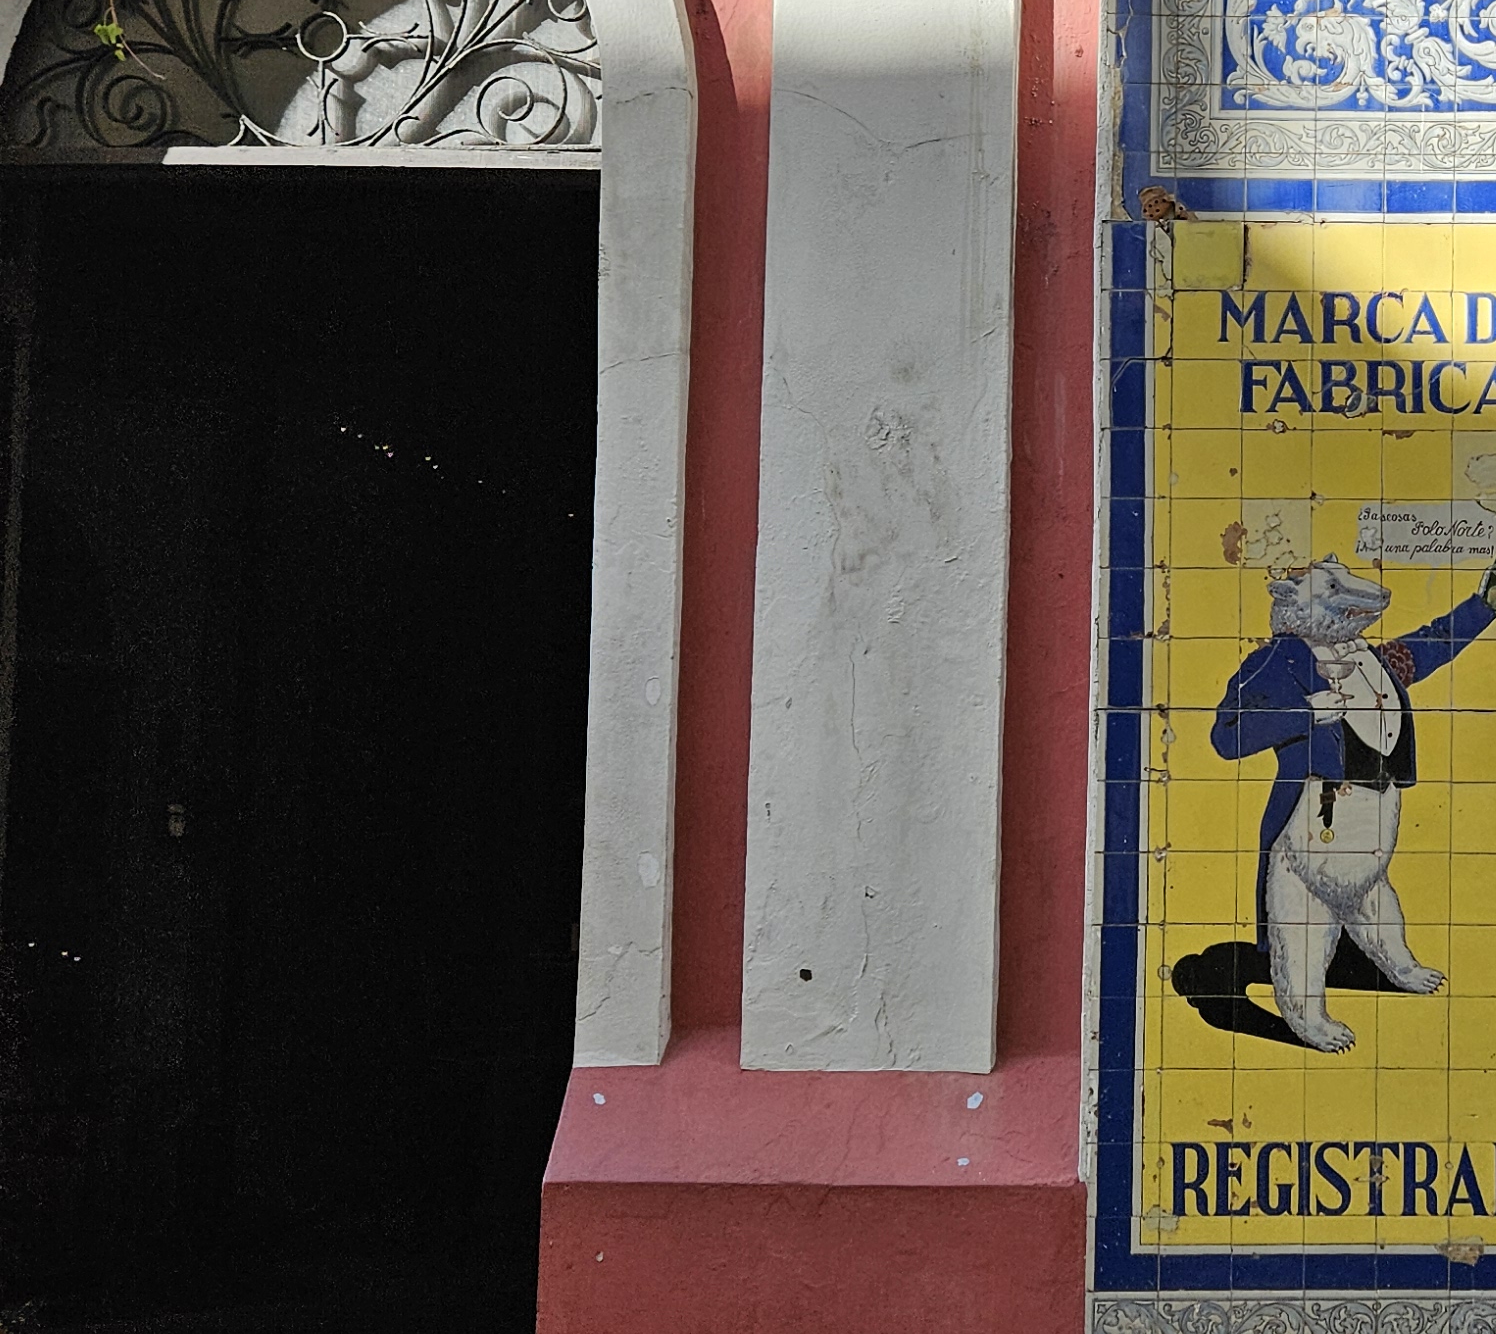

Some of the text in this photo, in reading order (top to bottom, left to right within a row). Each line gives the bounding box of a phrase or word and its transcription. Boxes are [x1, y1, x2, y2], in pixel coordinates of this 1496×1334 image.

[1218, 291, 1446, 345] MARCA
[1445, 519, 1494, 539] Norte?
[1384, 545, 1410, 554] una
[1409, 538, 1464, 560] palabra
